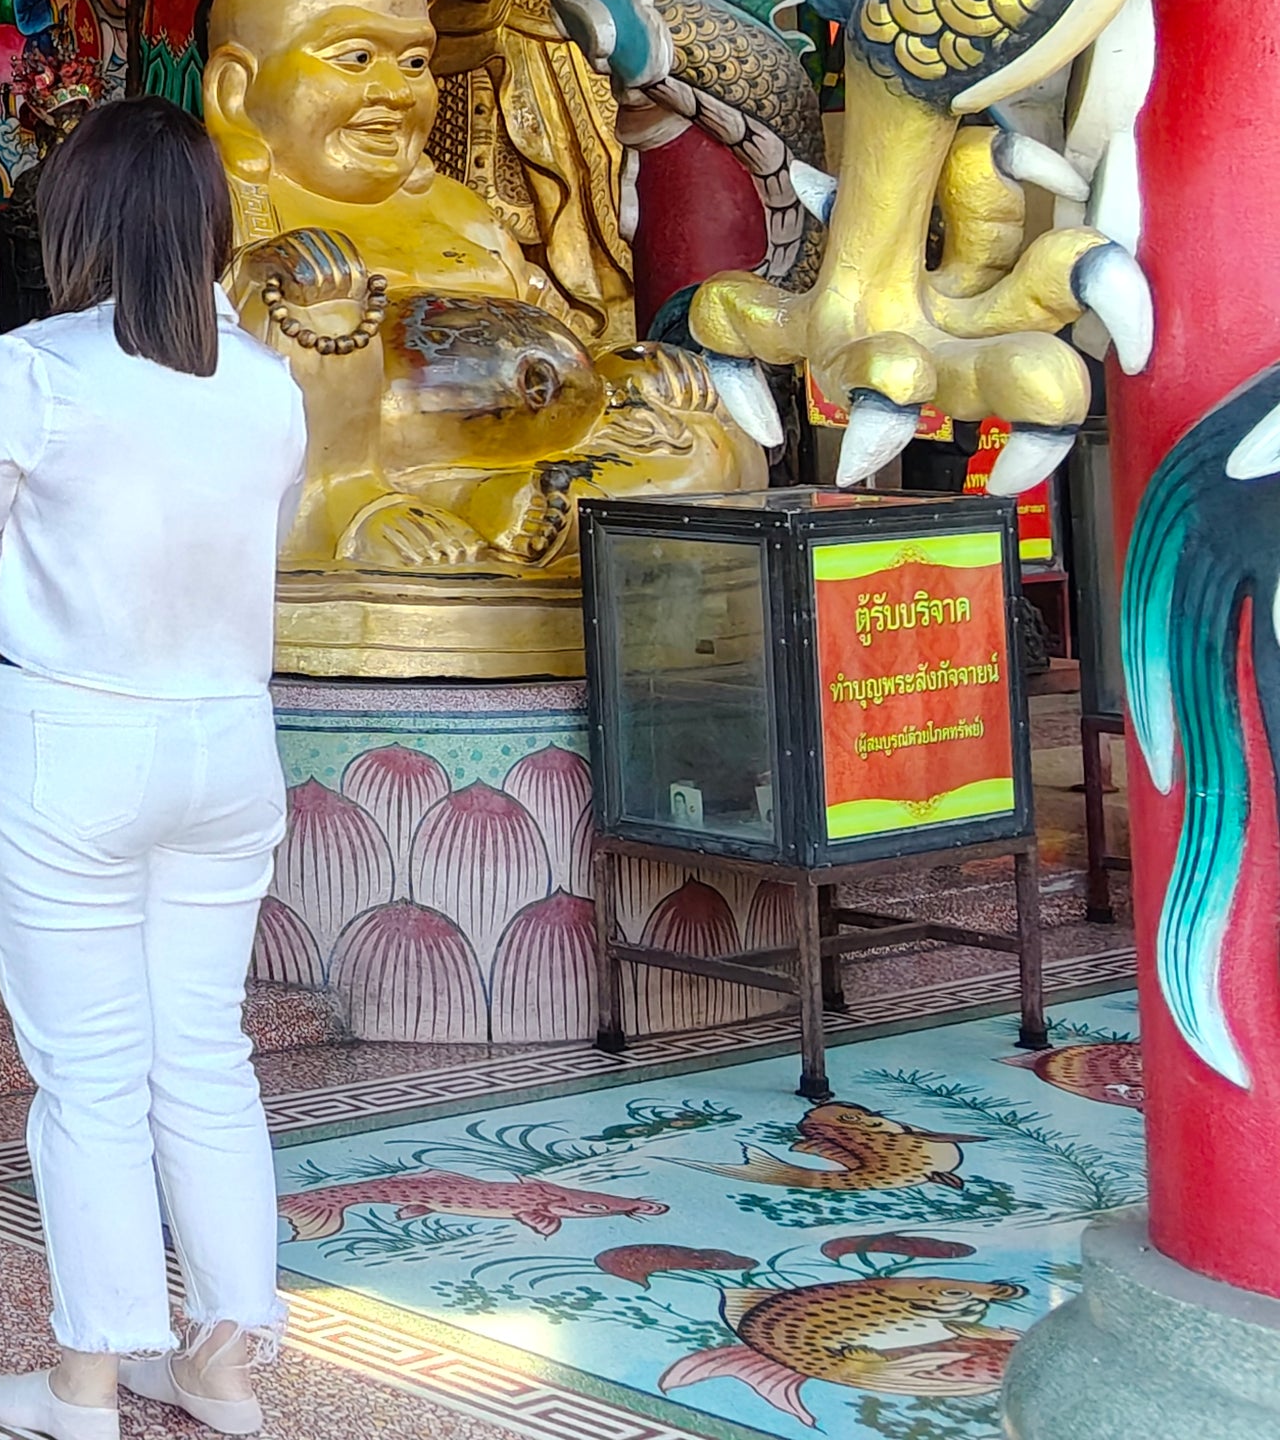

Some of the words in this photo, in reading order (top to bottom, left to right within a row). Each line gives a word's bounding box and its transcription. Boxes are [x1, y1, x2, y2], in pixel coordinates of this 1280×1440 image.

[854, 590, 971, 646] ตู้รับบริจาค
[829, 652, 1000, 709] ทำบุญพระสังกัจจายน์
